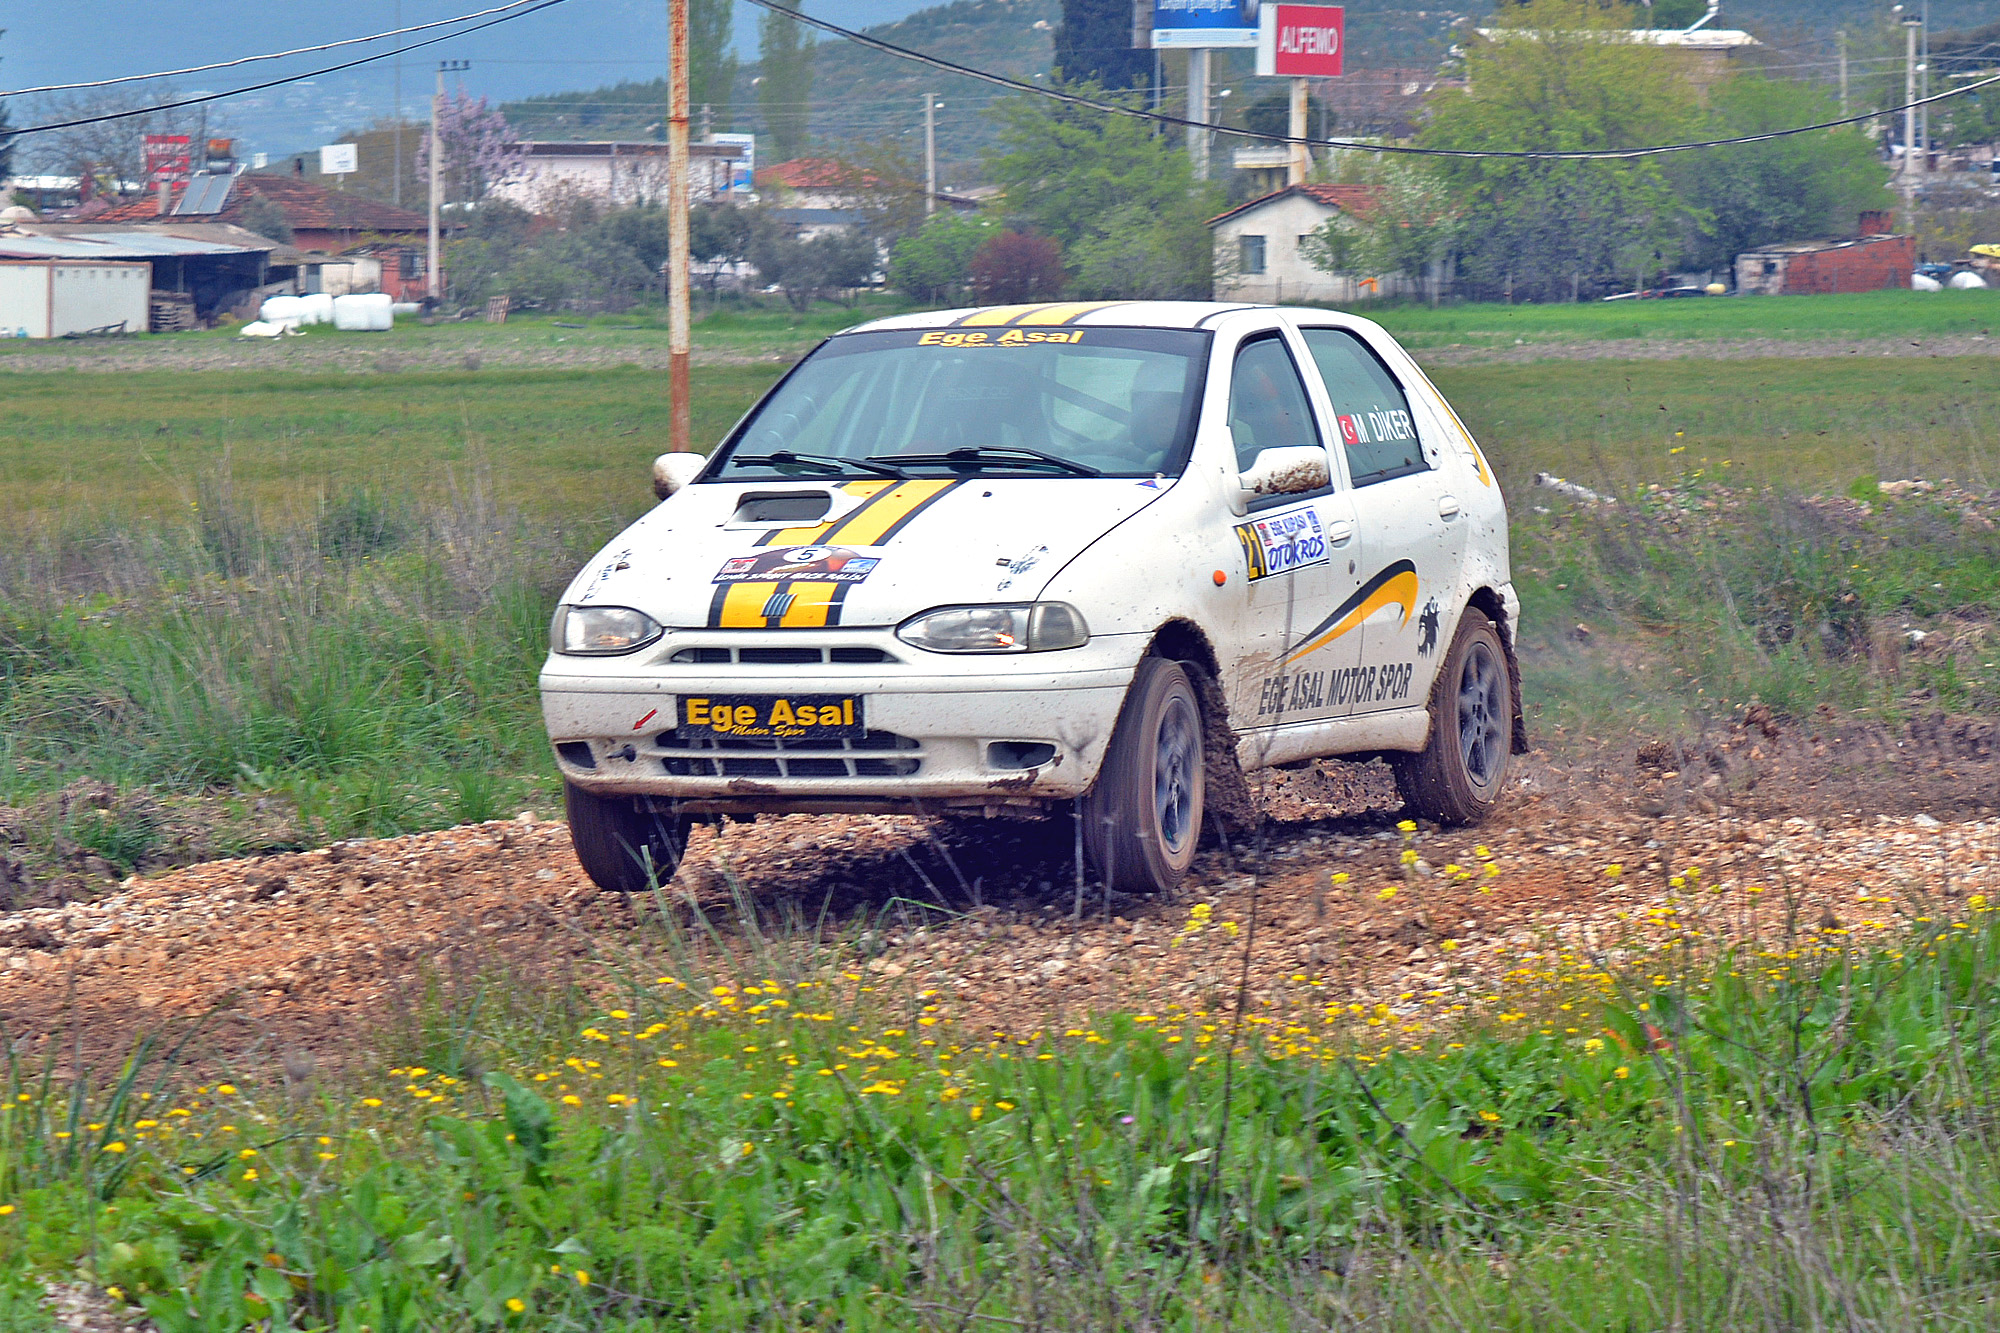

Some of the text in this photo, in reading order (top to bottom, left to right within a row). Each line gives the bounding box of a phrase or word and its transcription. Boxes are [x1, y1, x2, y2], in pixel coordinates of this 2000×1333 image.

[1278, 26, 1339, 55] ALFEMO
[918, 329, 1084, 347] Ege Asal
[1350, 413, 1371, 443] M
[797, 549, 819, 560] 5
[1236, 524, 1266, 579] 21
[1268, 534, 1325, 570] OTOKROS
[1258, 663, 1413, 715] EGE ASAL MOTOR SPOR
[686, 698, 854, 732] Ege Asal
[730, 724, 806, 737] Motor Spor
